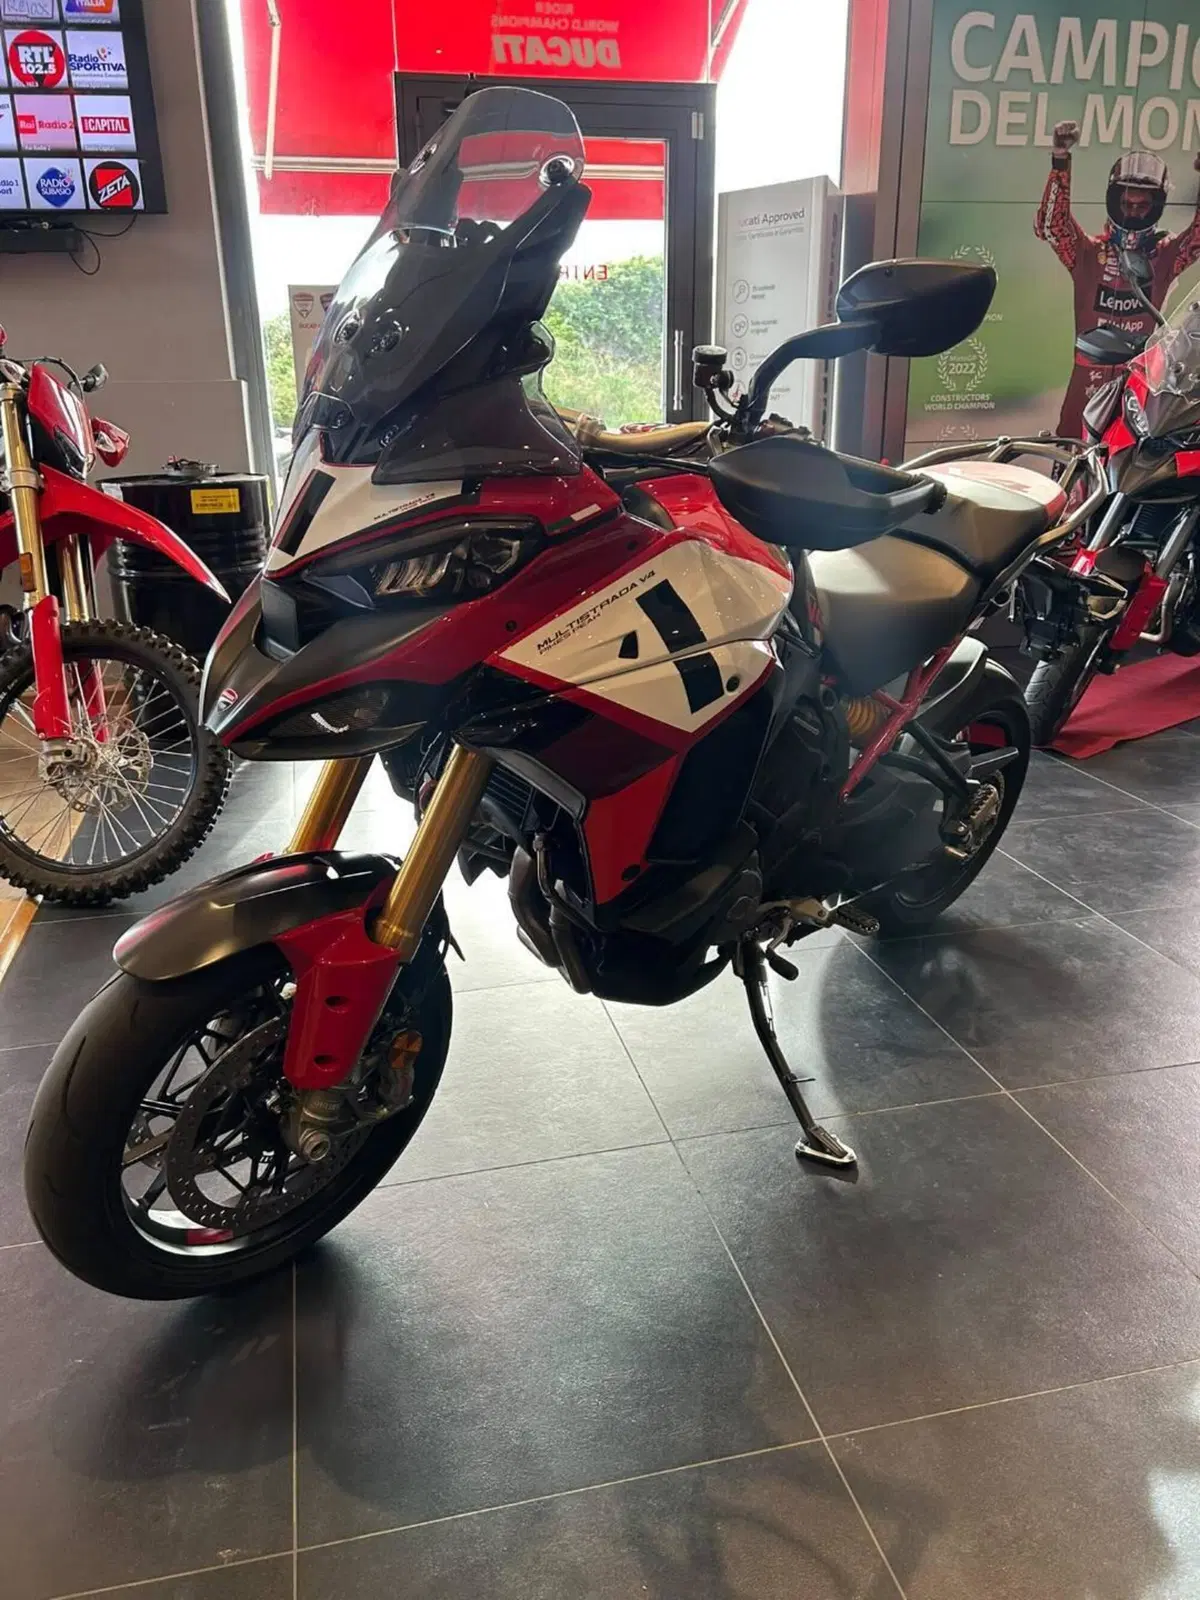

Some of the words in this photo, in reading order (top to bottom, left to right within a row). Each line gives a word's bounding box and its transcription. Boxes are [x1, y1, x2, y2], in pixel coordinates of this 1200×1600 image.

[17, 45, 55, 62] RTL
[951, 10, 1200, 91] CAMPI
[68, 54, 99, 63] Radio
[20, 62, 56, 74] 102.5
[69, 62, 125, 72] SPORTIVA
[949, 89, 1055, 147] DEL
[38, 120, 67, 130] Radio
[88, 118, 128, 132] CAPITAL
[40, 178, 72, 188] RADIO
[98, 175, 131, 204] ZETA
[41, 187, 72, 196] SUBASIO
[761, 206, 806, 225] Approved
[1099, 290, 1143, 311] Lenov
[948, 362, 977, 374] 2022
[924, 403, 953, 411] WORLD
[954, 402, 996, 410] CHAMPION
[536, 582, 639, 651] MULTISTRADA
[639, 569, 657, 584] V4
